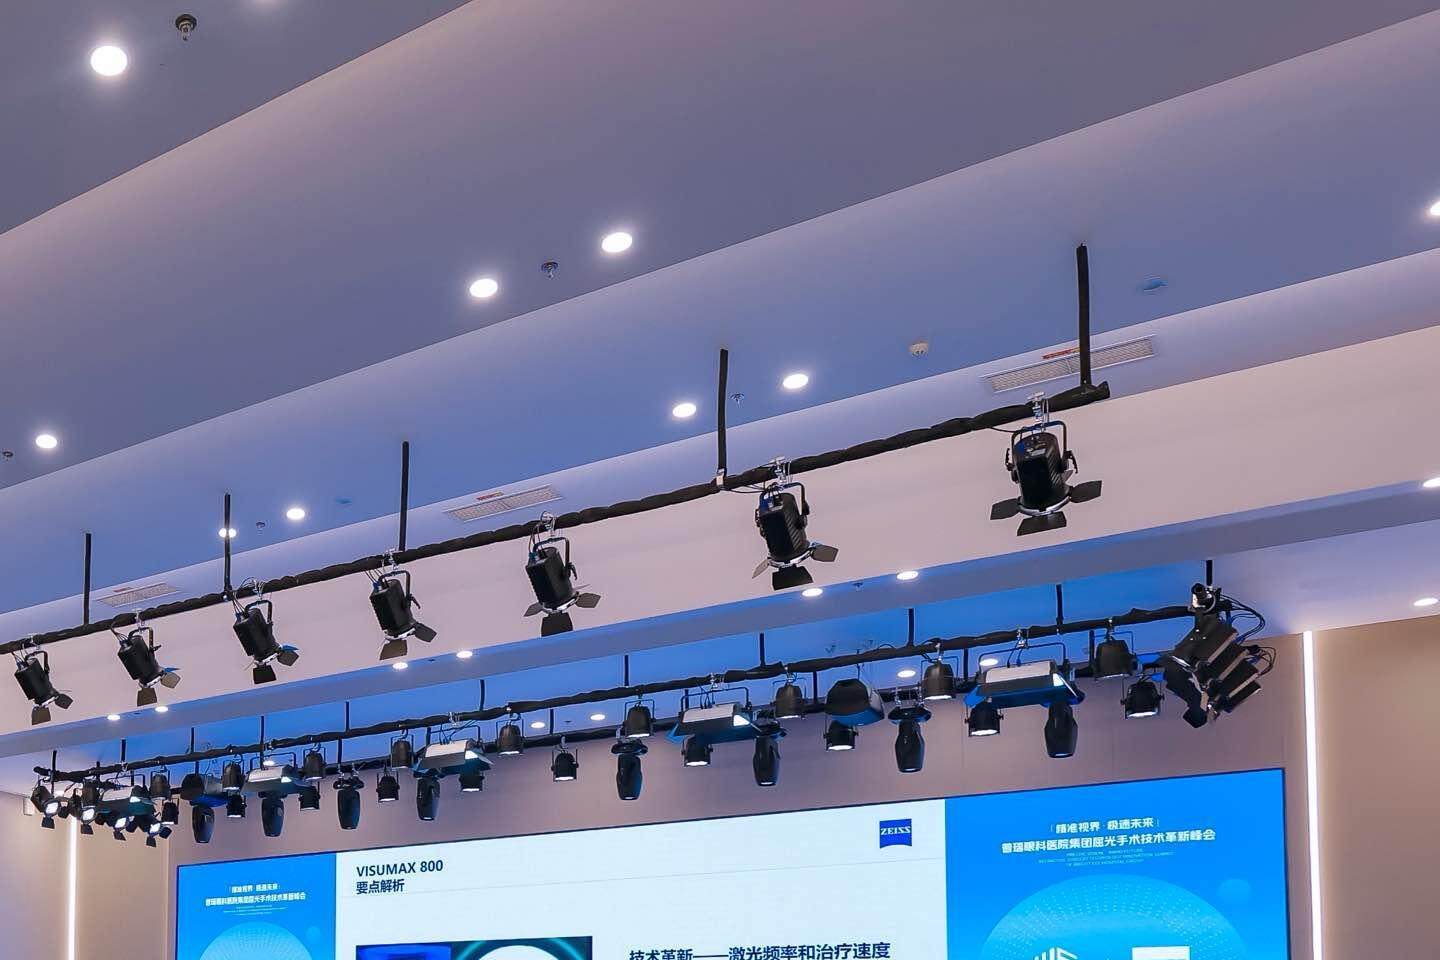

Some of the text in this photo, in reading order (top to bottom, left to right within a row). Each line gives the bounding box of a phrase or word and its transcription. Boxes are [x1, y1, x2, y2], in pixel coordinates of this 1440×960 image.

[880, 826, 911, 835] ZEISS
[356, 859, 444, 877] VISUMAX 800
[356, 878, 405, 895] 要点解析
